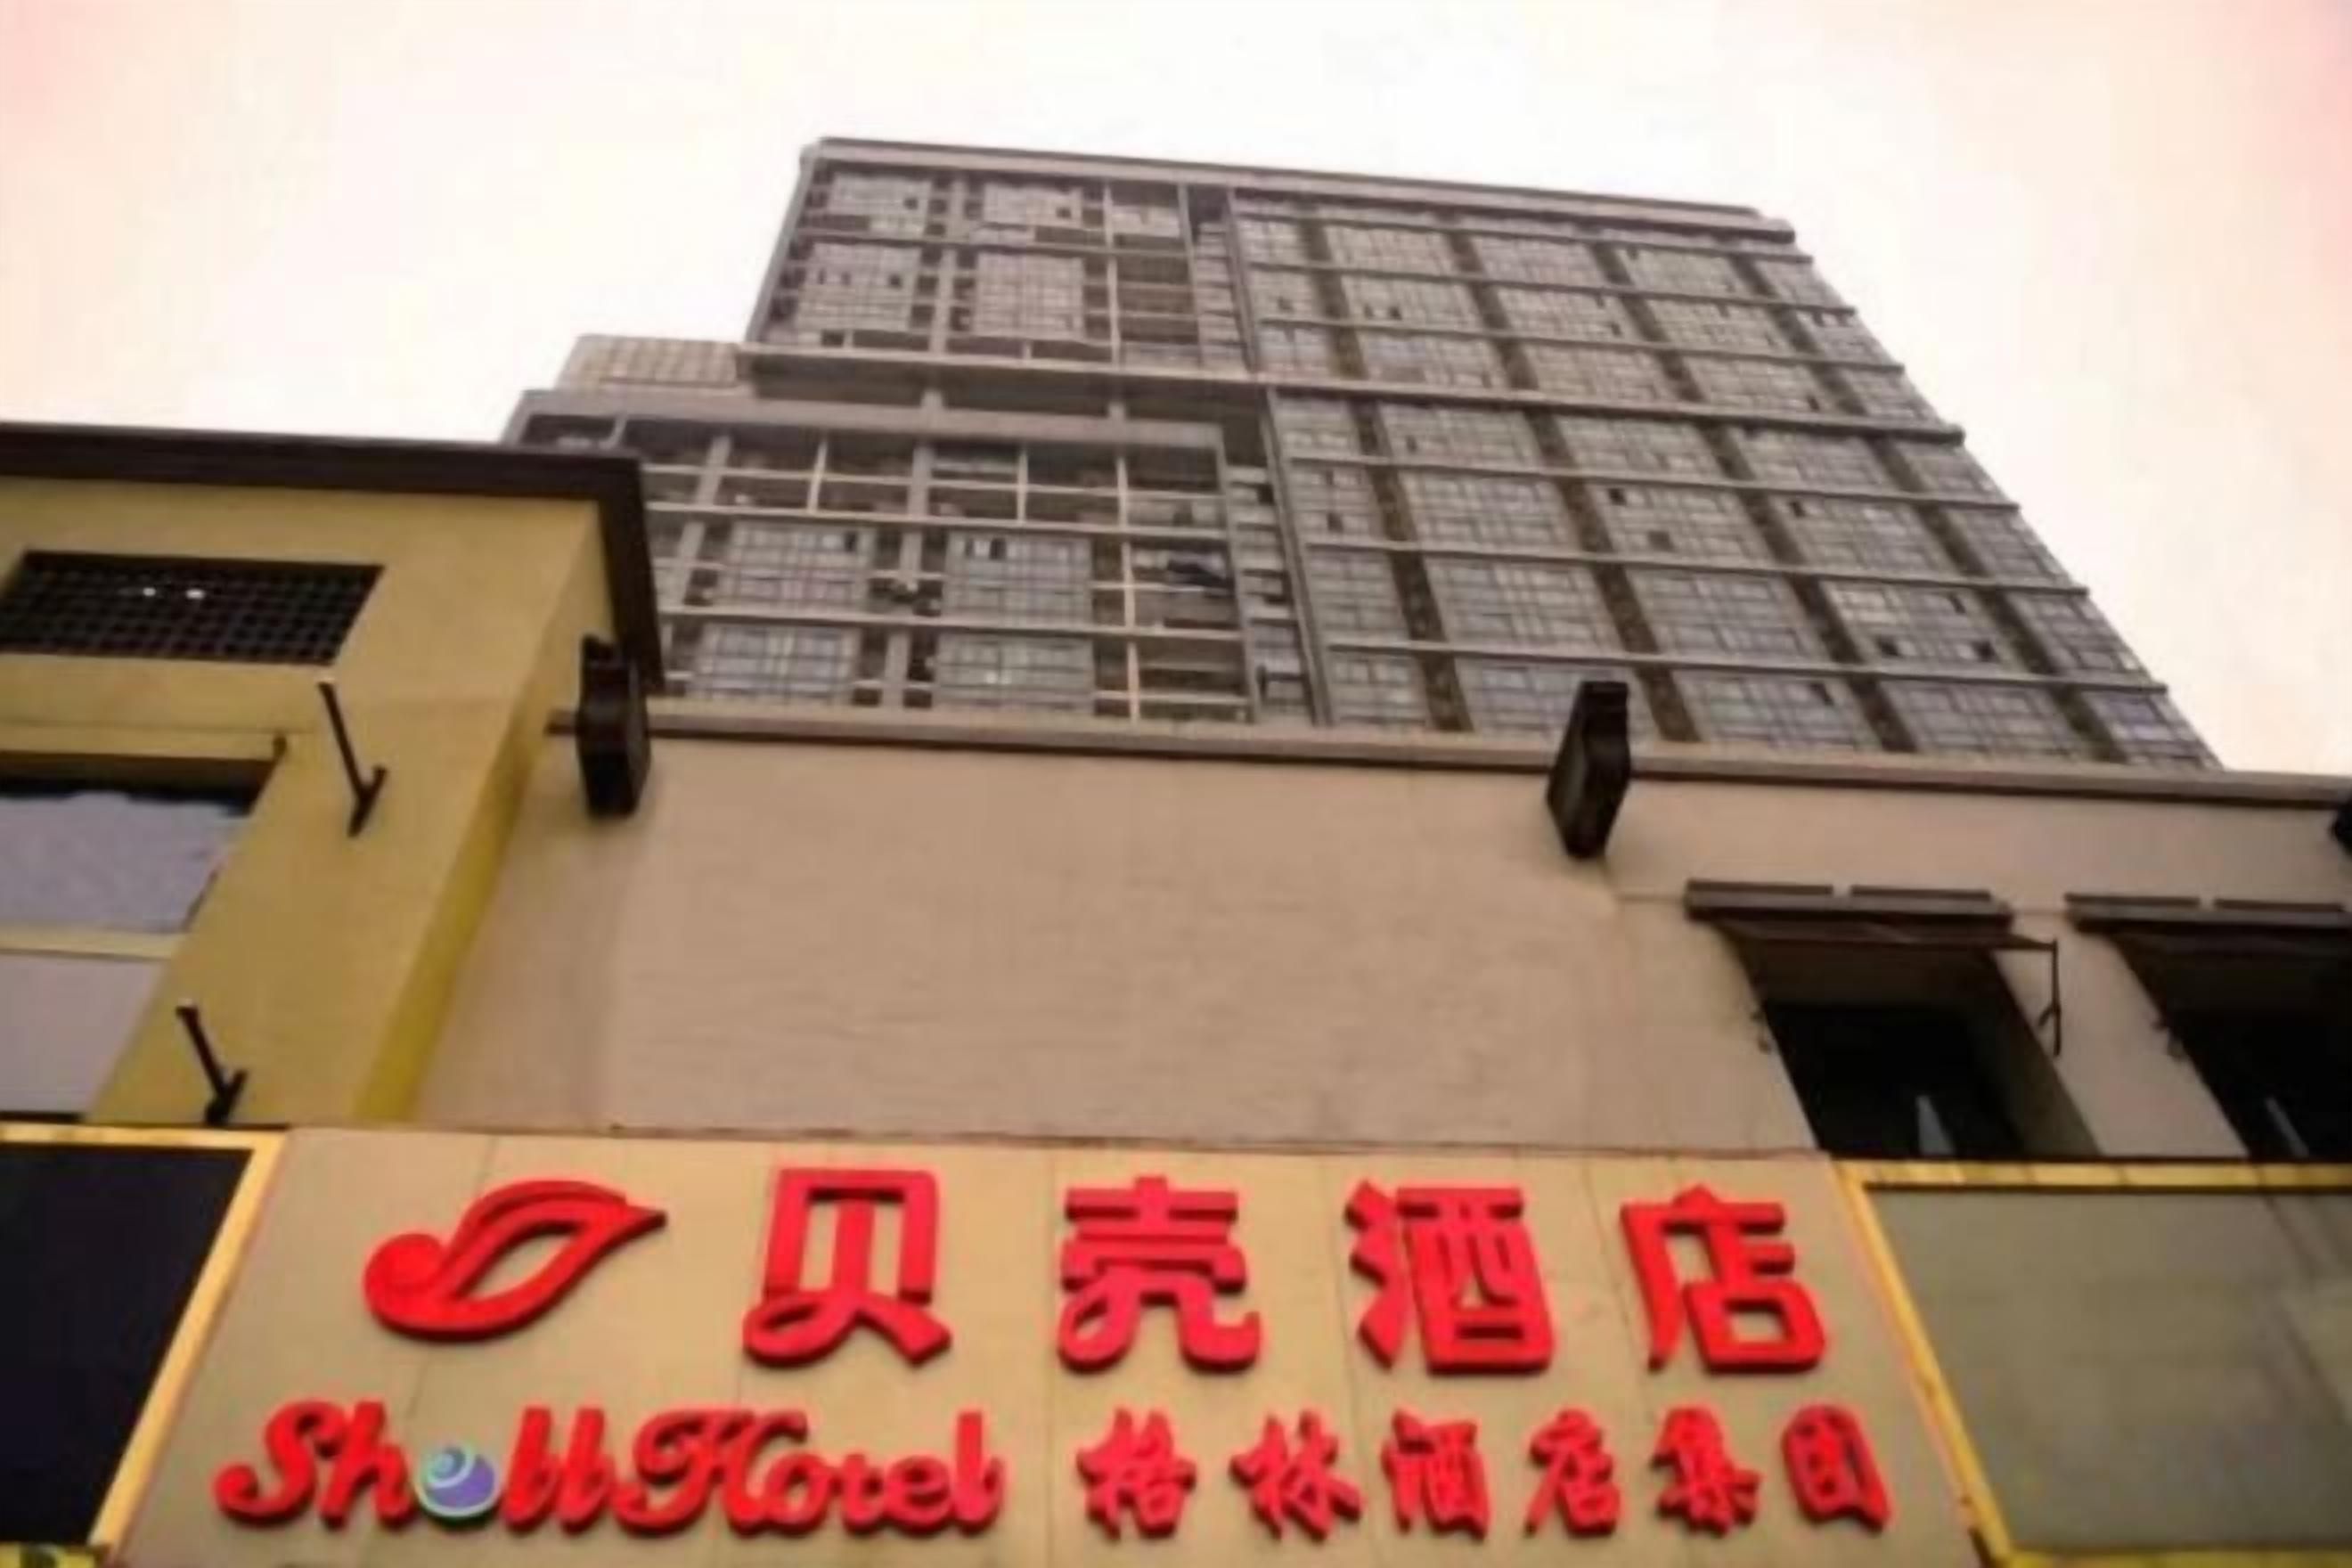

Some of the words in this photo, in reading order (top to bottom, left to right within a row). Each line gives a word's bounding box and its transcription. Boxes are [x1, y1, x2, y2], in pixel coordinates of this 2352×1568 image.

[742, 1165, 1830, 1376] 贝壳酒店
[1076, 1405, 1893, 1539] 格林酒店集团
